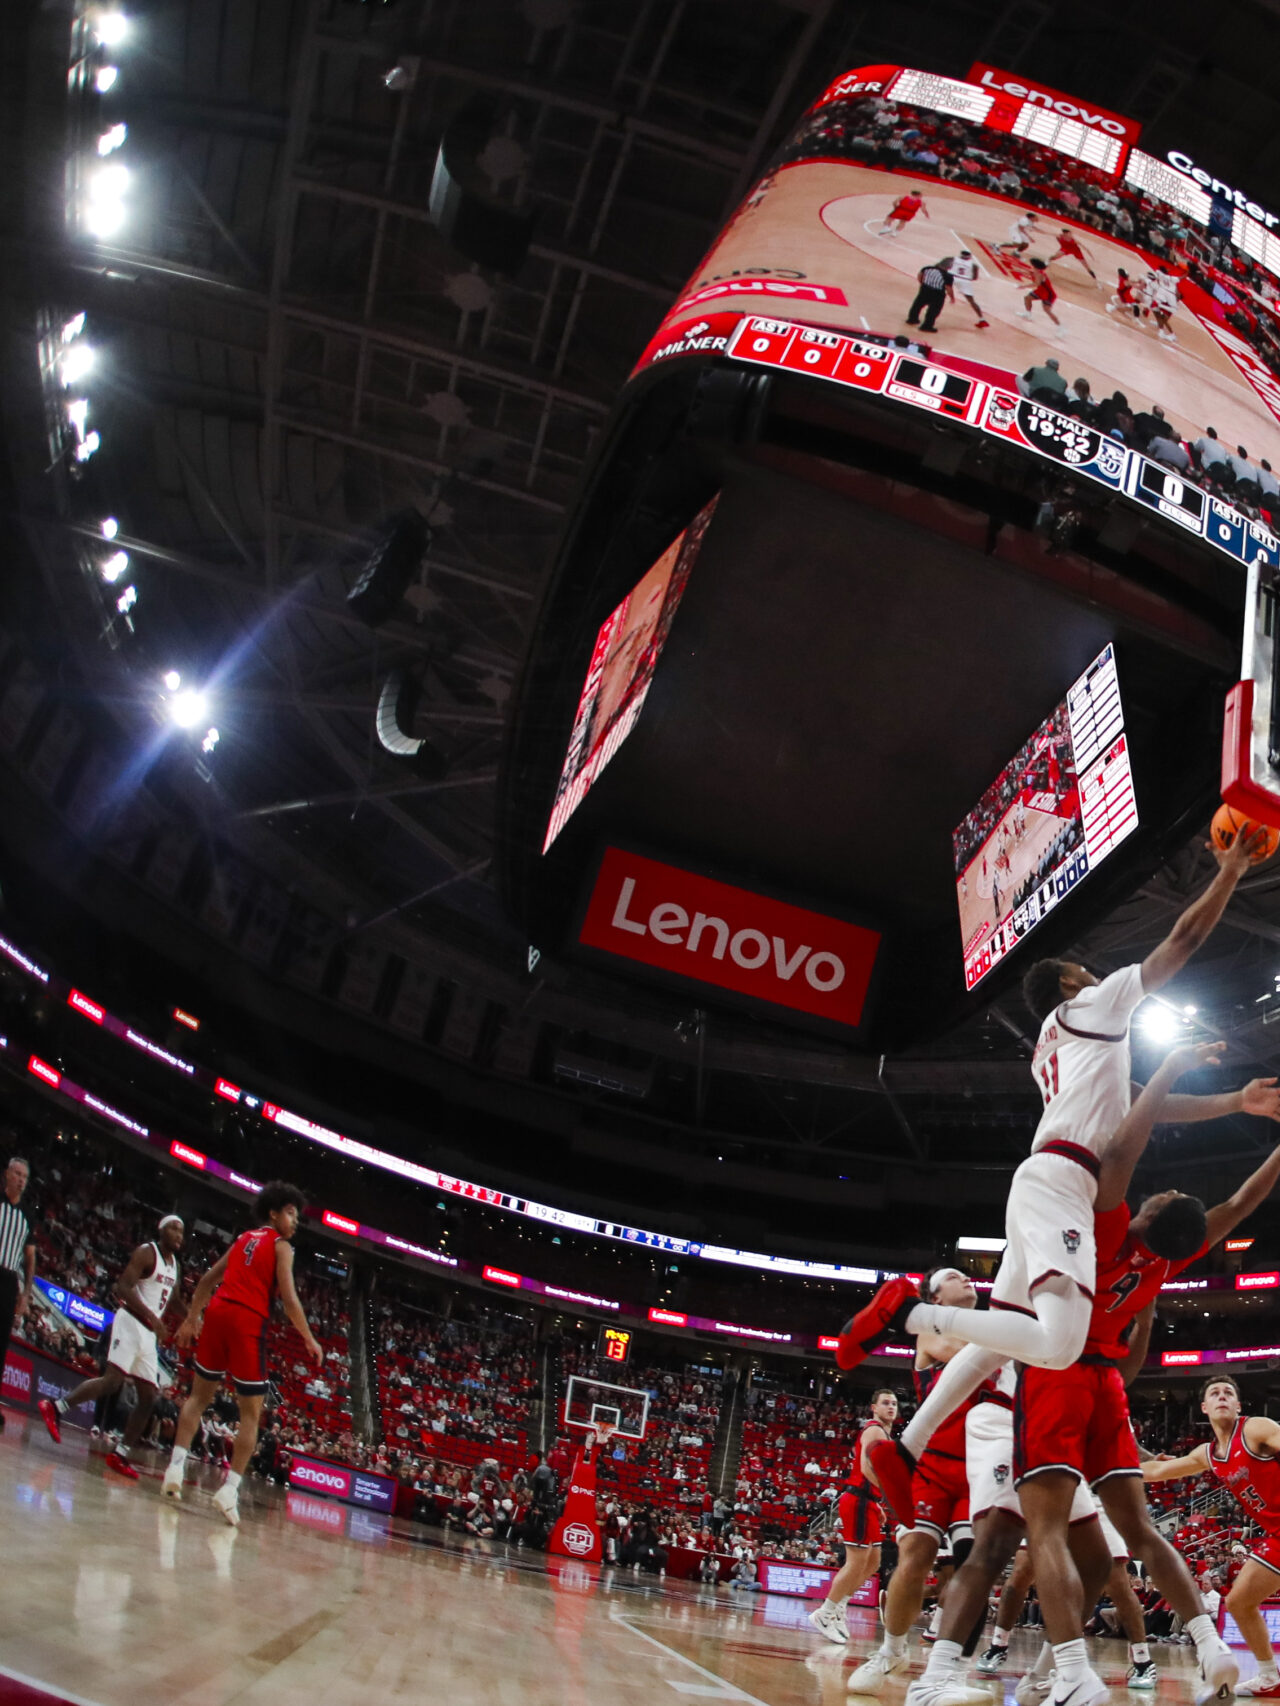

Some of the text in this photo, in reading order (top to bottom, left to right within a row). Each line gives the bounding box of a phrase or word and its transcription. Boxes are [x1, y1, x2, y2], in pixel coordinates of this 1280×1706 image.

[834, 82, 881, 96] NER
[981, 70, 1126, 135] Lenovo
[1167, 151, 1280, 228] Center
[755, 319, 786, 334] AST
[653, 336, 728, 361] MILNER
[752, 338, 770, 352] 0
[804, 330, 835, 346] STL
[804, 350, 821, 364] 0
[859, 345, 883, 359] TO
[854, 363, 871, 377] 0
[920, 367, 947, 394] 0
[1031, 406, 1090, 437] 1ST HALF
[1027, 415, 1091, 455] 19:42
[1163, 475, 1184, 505] 0
[1215, 502, 1239, 526] AST
[1218, 524, 1231, 541] 0
[1251, 526, 1275, 550] STL
[611, 877, 846, 992] Lenovo
[72, 994, 102, 1019] Lenovo
[32, 1060, 58, 1083] Lenovo
[1041, 1050, 1058, 1104] 11
[174, 1144, 204, 1165] Lenovo
[326, 1214, 356, 1231] Lenovo
[244, 1238, 260, 1266] 4
[487, 1268, 518, 1284] Lenovo
[1239, 1276, 1276, 1286] Lenovo
[159, 1289, 169, 1311] 5
[1105, 1272, 1142, 1312] 9
[71, 1300, 105, 1321] Advanced
[652, 1310, 684, 1323] Lenovo
[607, 1341, 624, 1360] 13
[1164, 1354, 1199, 1363] Lenovo
[3, 1364, 31, 1391] enovo
[355, 1484, 389, 1499] technology
[356, 1477, 380, 1489] Smarter
[580, 1487, 595, 1496] PNC
[566, 1532, 591, 1545] CPI
